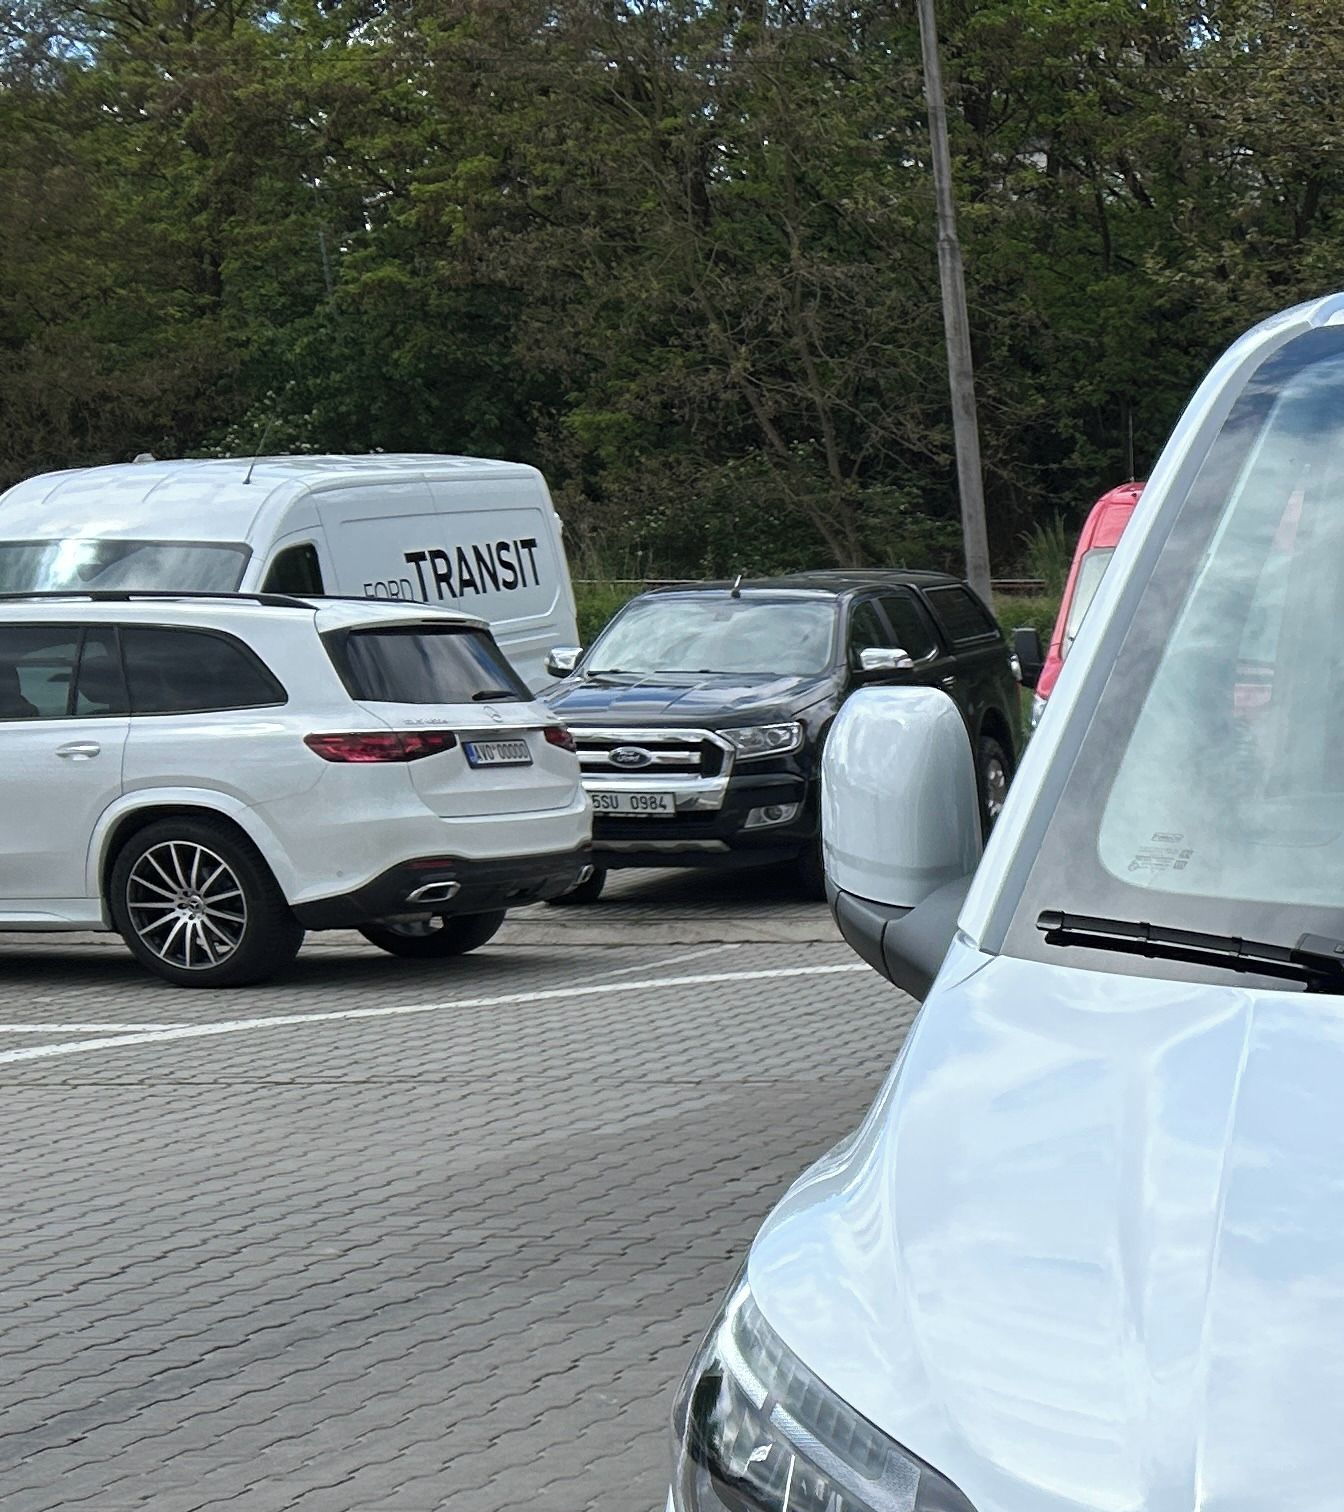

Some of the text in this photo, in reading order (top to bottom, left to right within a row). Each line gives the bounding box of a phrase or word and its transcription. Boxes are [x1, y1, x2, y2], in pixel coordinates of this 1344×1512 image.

[363, 538, 540, 602] FORD TRANSIT
[592, 794, 667, 811] 5SU 0984
